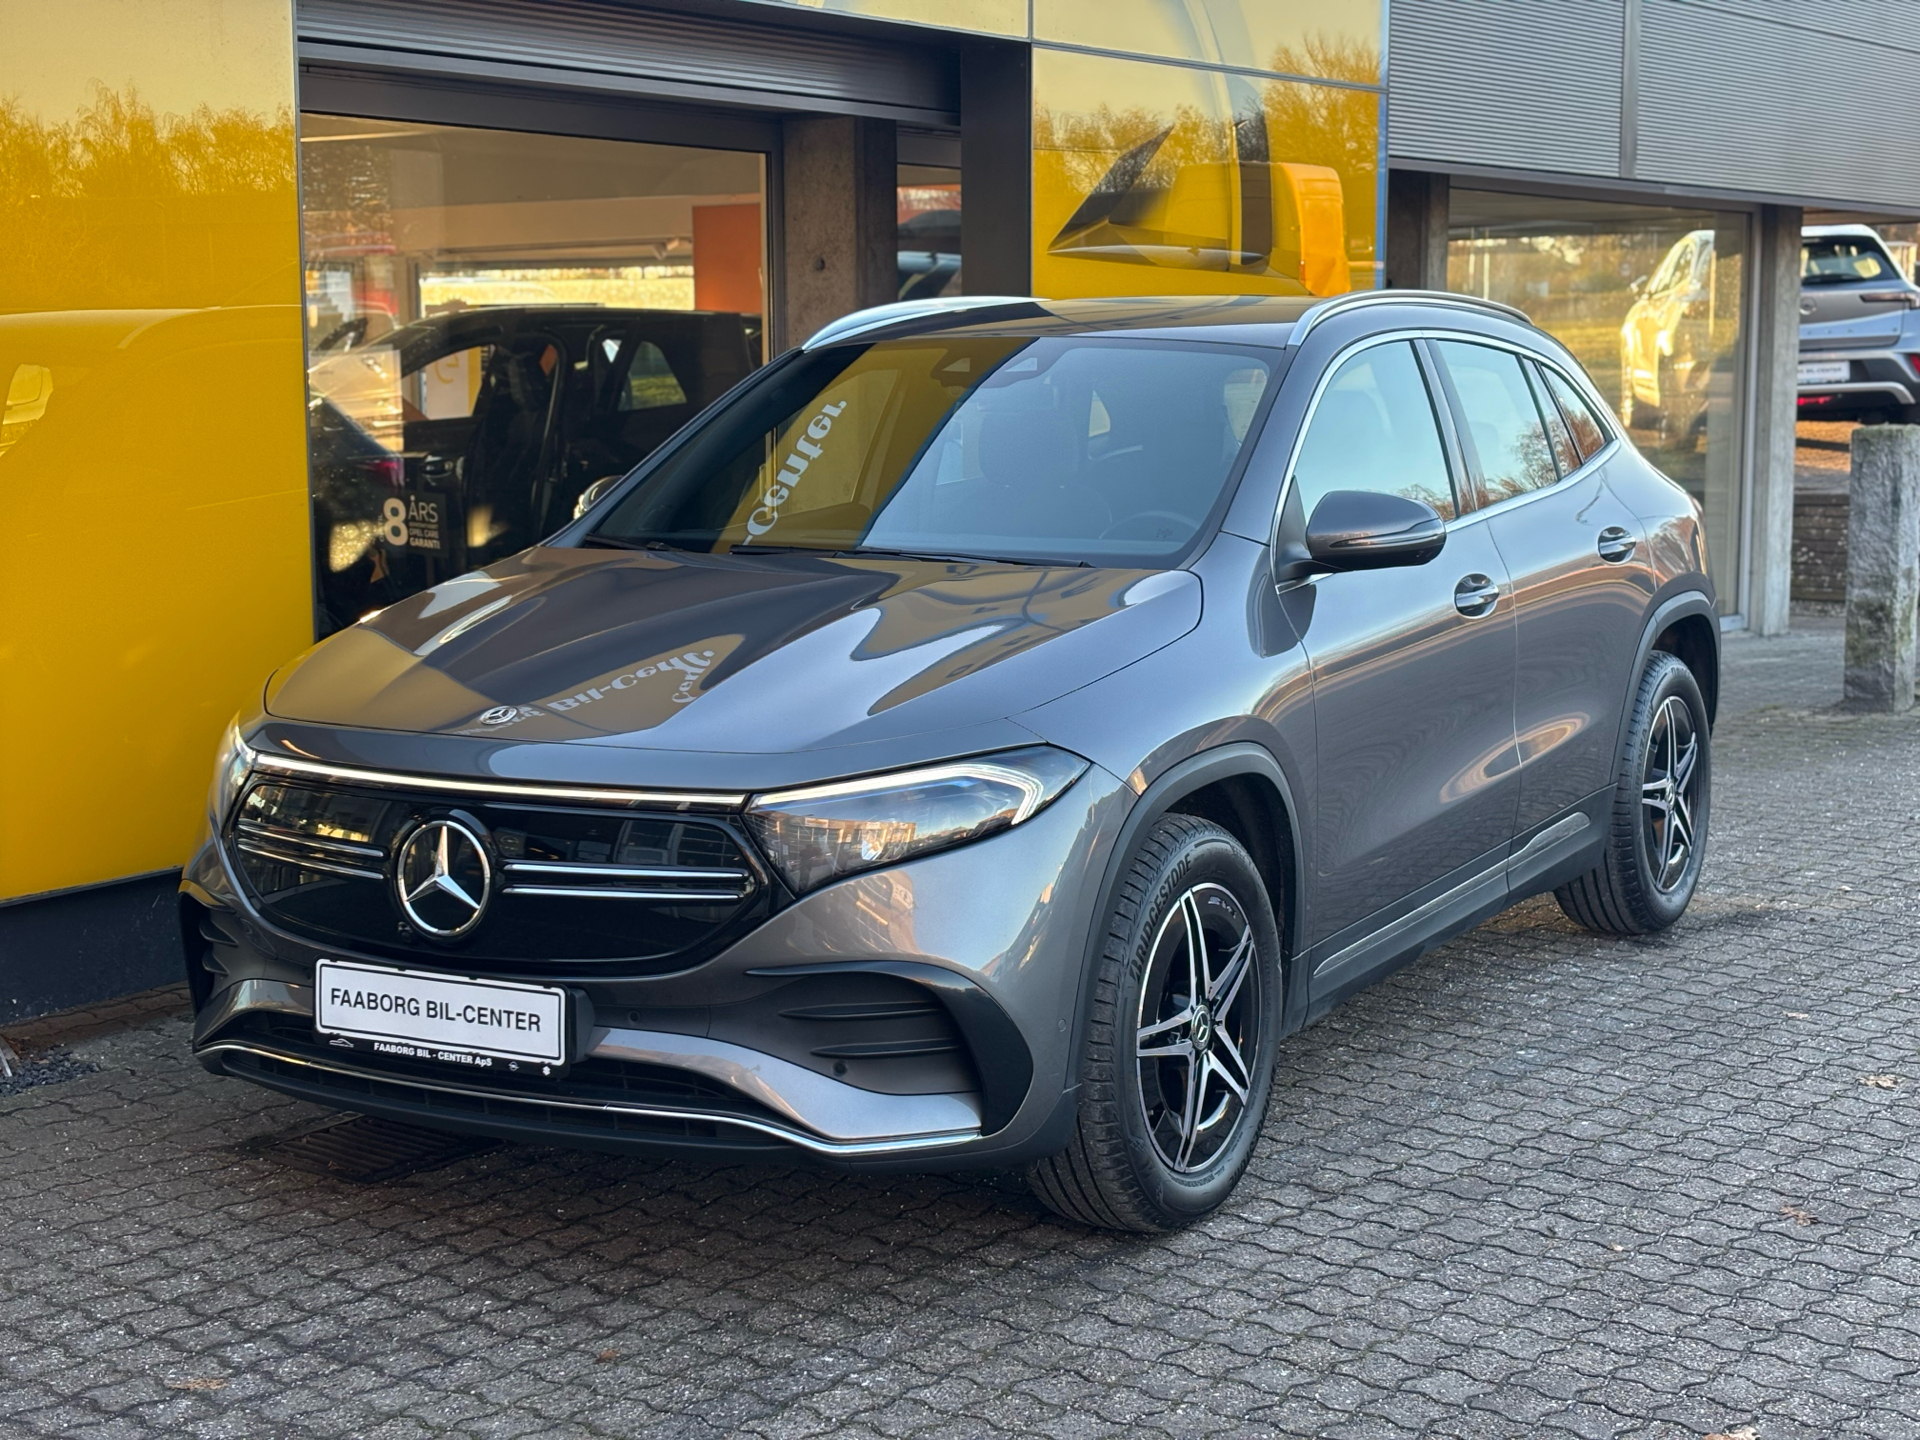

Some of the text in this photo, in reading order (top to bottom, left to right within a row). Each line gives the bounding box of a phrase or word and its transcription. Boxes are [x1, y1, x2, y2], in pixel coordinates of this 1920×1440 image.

[383, 497, 408, 546] 8
[408, 494, 438, 523] ÅRS
[409, 537, 441, 550] GARANTI
[1129, 853, 1193, 983] BRIDGESTONE
[331, 987, 542, 1033] FAABORG BIL-CENTER
[374, 1042, 415, 1057] FAABORG
[416, 1048, 431, 1059] BIL
[437, 1050, 473, 1066] CENTER
[474, 1055, 493, 1068] ApS
